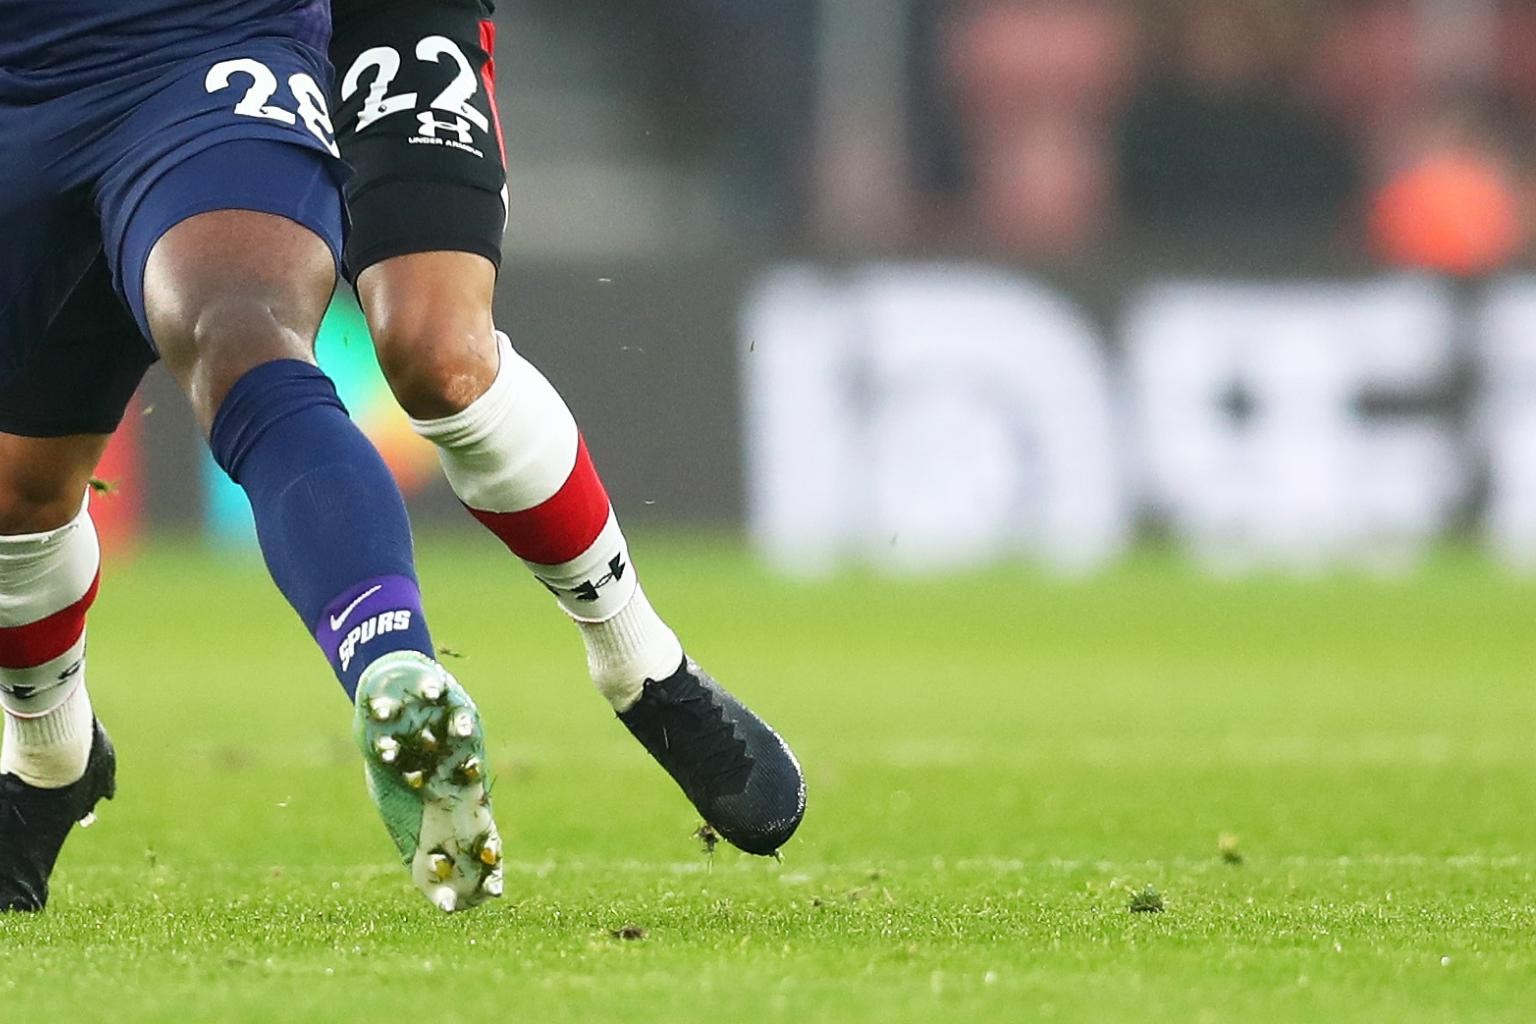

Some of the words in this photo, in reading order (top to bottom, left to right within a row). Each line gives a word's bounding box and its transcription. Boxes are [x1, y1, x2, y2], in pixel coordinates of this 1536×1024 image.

[340, 34, 489, 134] 22
[407, 136, 444, 145] UNDER
[338, 609, 412, 672] SPURS
